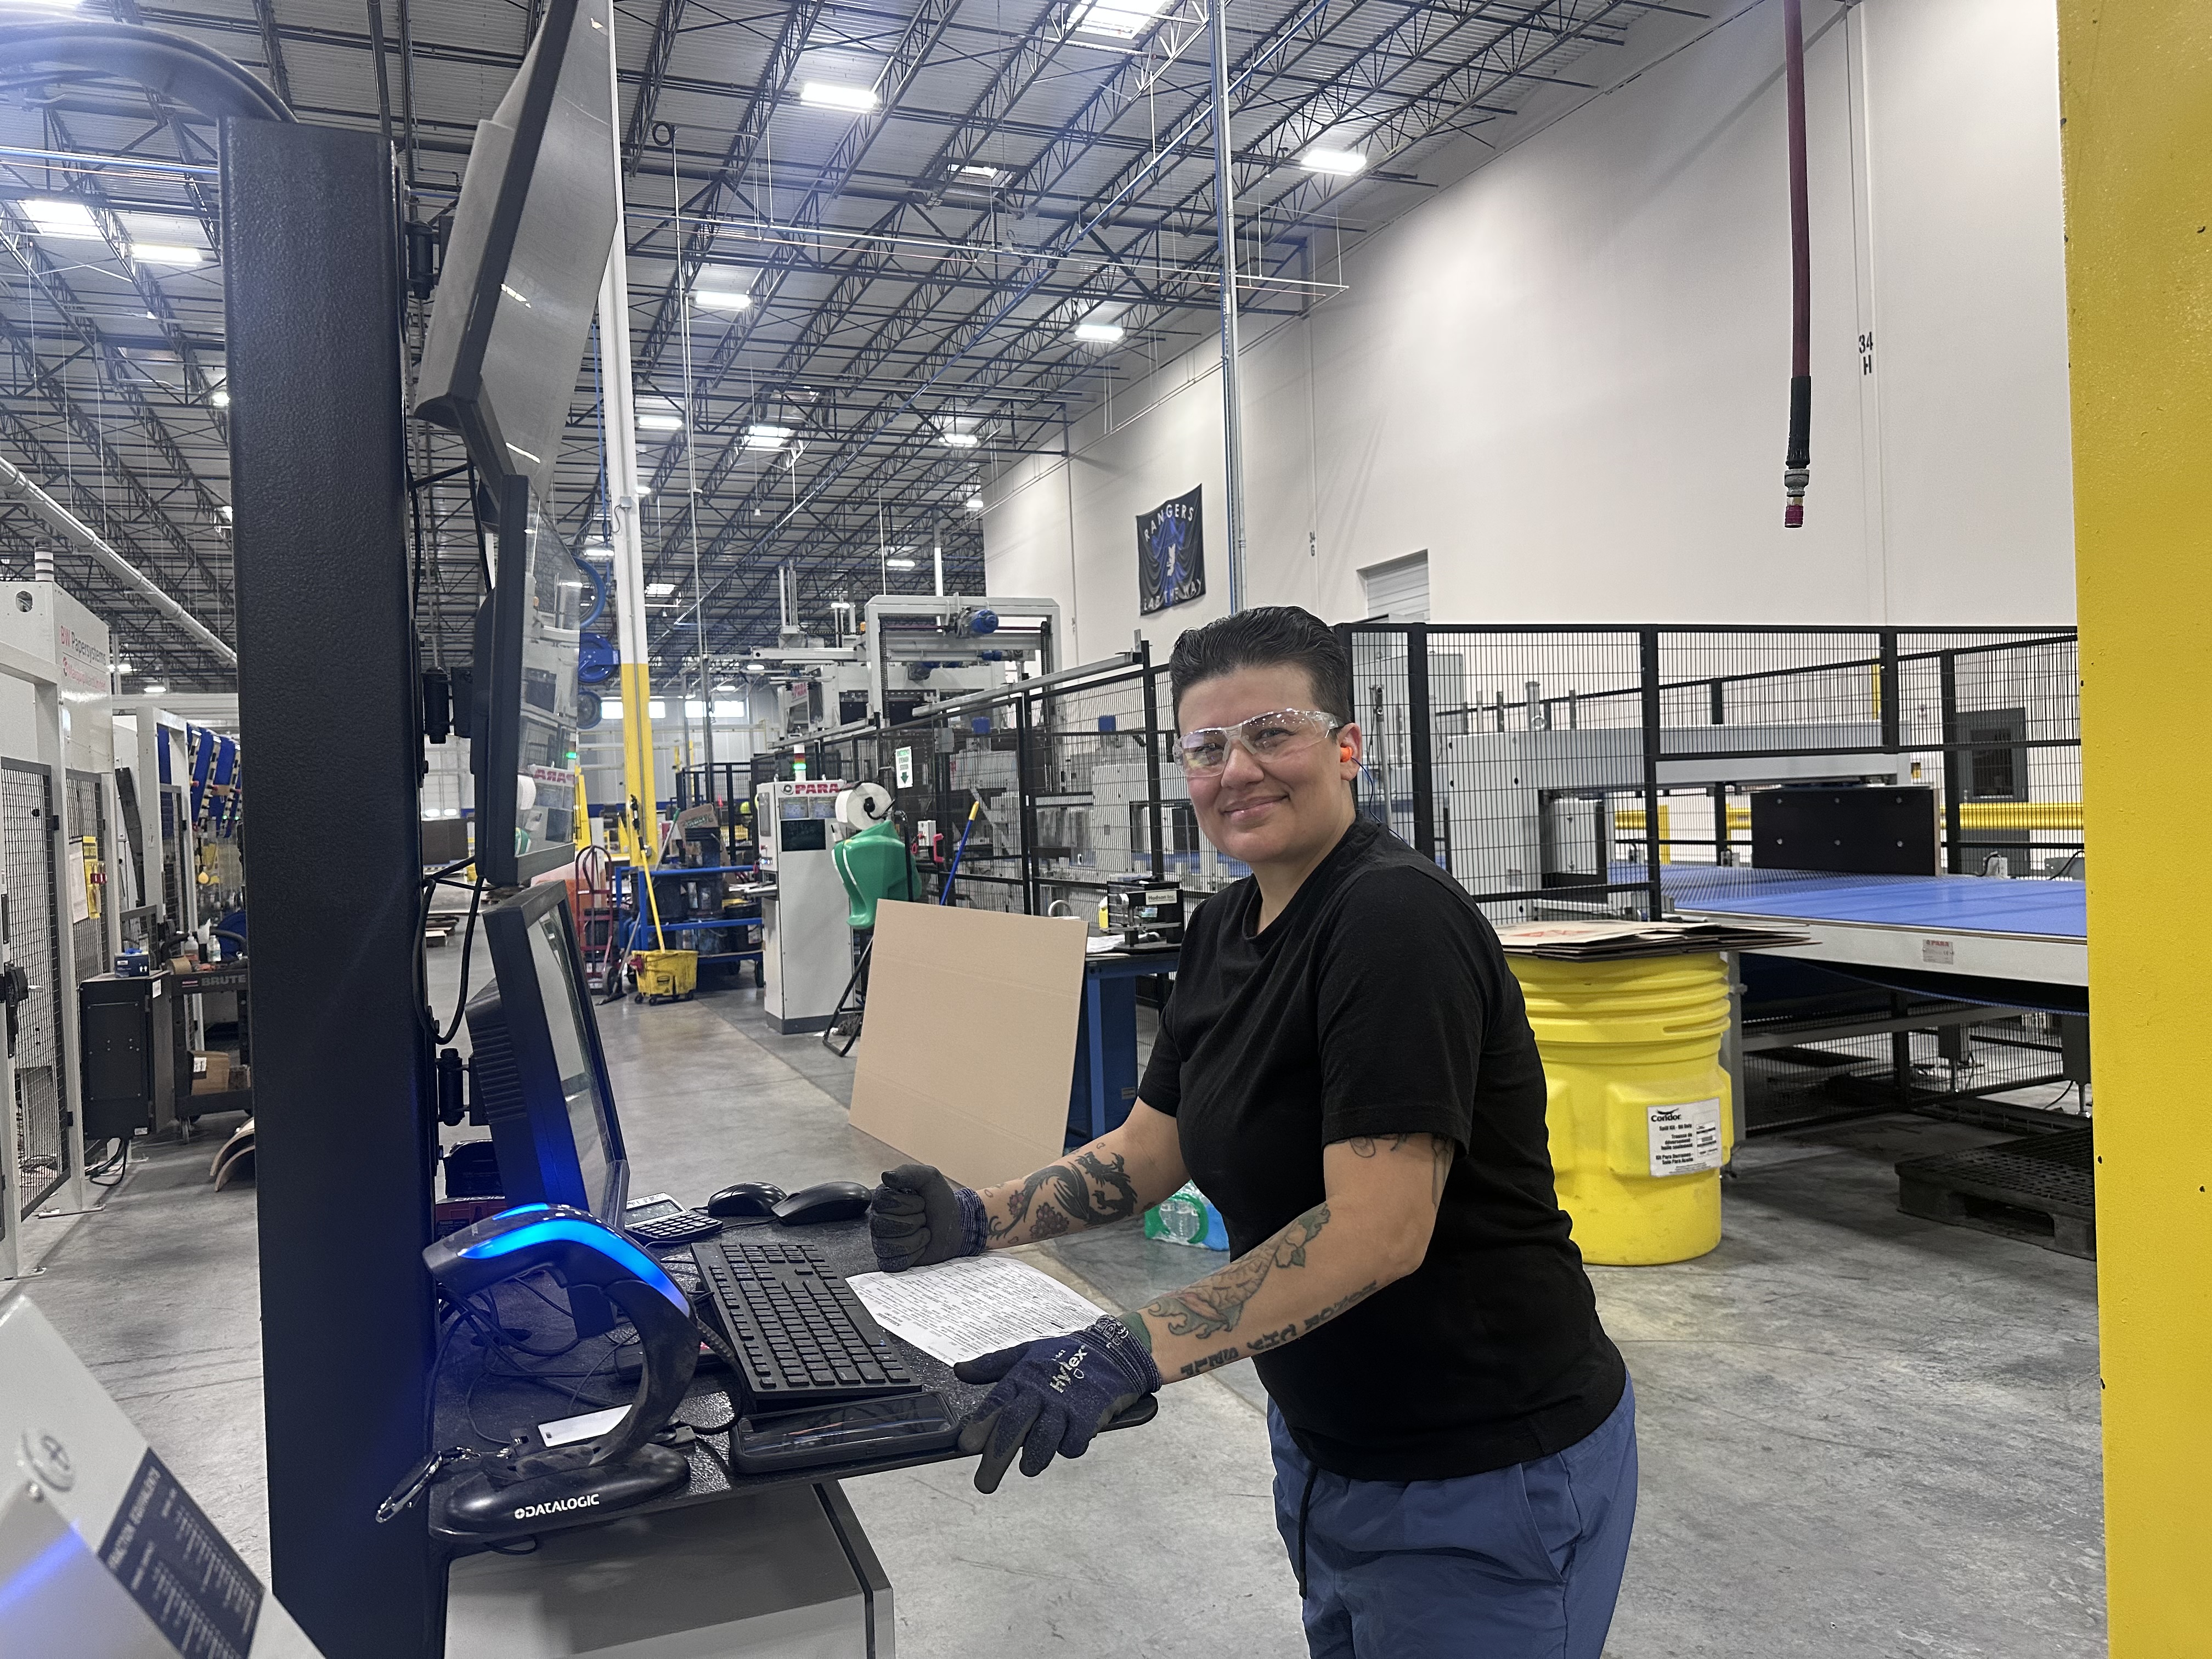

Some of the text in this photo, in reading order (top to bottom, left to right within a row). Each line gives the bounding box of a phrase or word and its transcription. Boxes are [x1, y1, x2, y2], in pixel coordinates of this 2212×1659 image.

[1859, 331, 1873, 354] 34
[1863, 354, 1872, 375] H
[1144, 504, 1194, 542] RANGERS
[1311, 544, 1315, 556] G
[1164, 588, 1179, 603] THE
[1183, 579, 1202, 598] WAY
[60, 625, 106, 666] BW Papersystems
[795, 783, 840, 794] PARA
[202, 974, 246, 986] BRUTE
[1651, 1114, 1681, 1122] Condor
[525, 1493, 600, 1517] DATALOGIC
